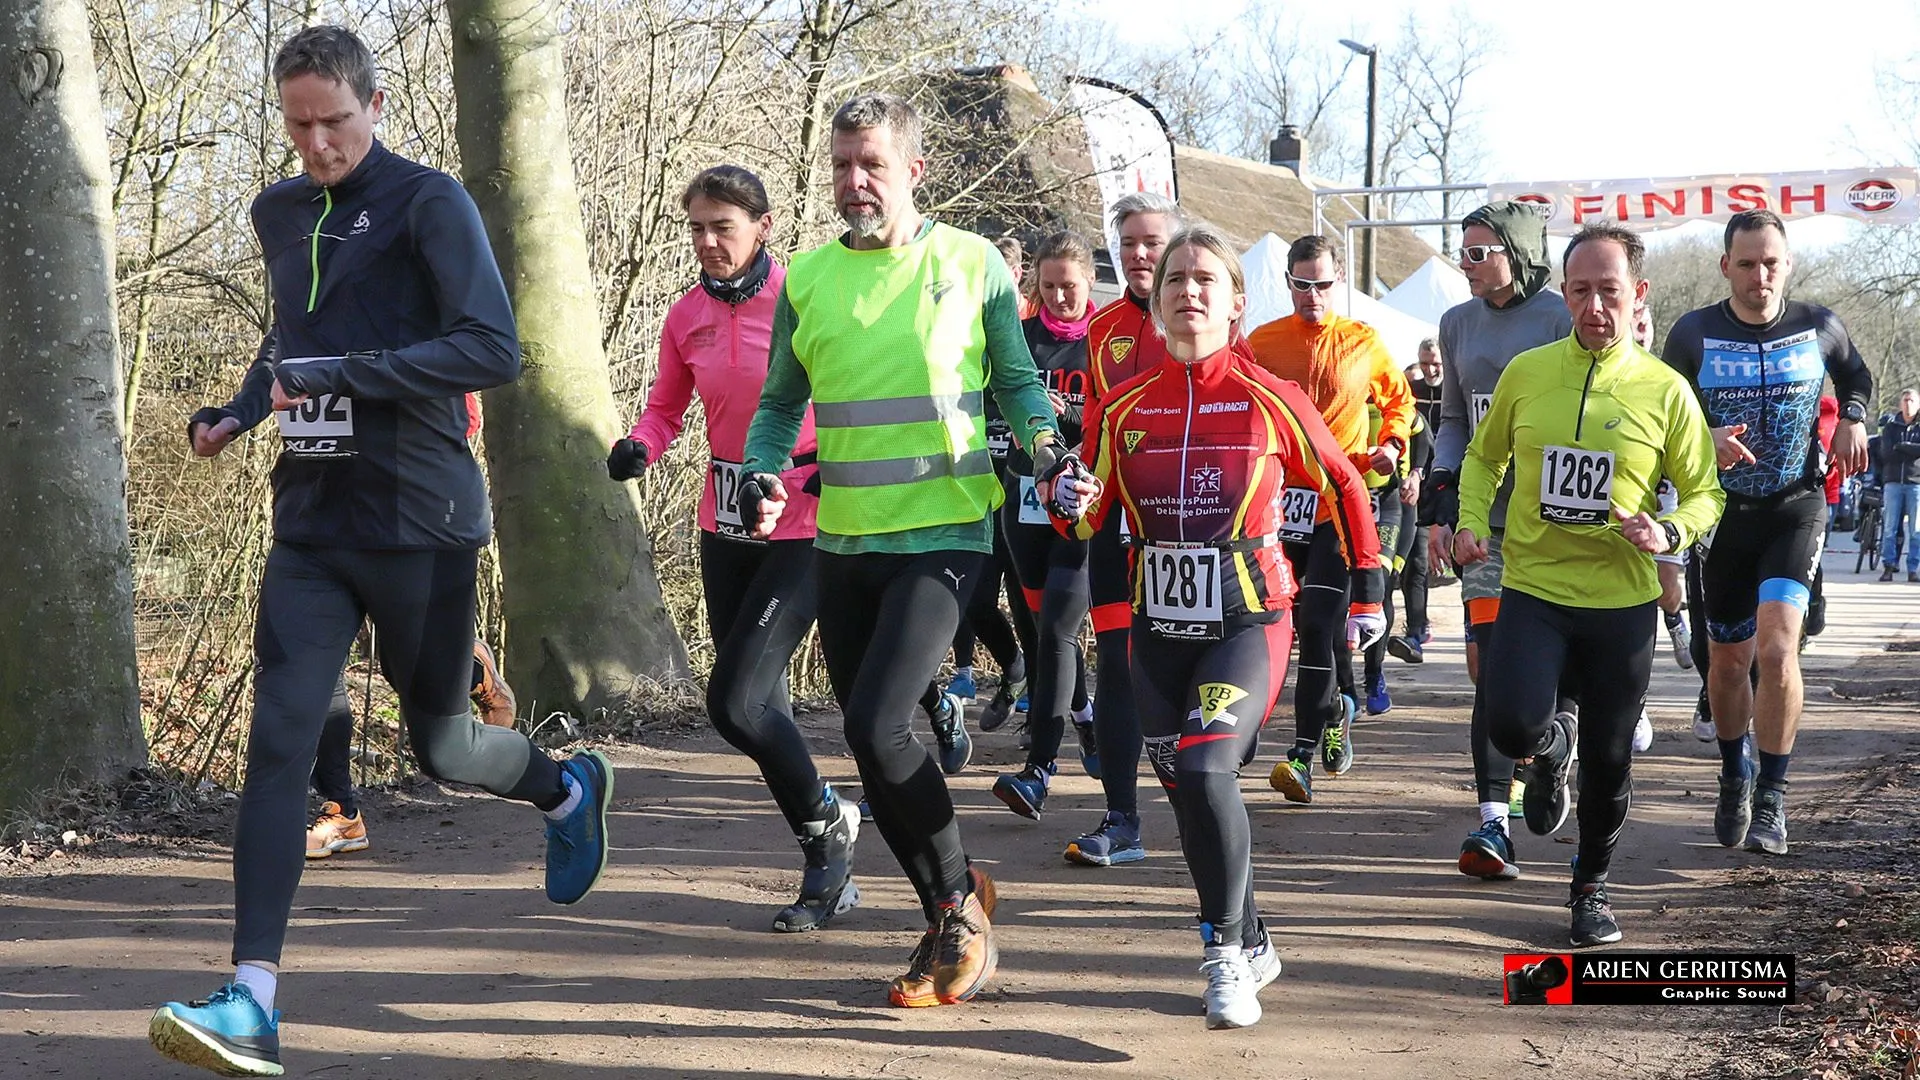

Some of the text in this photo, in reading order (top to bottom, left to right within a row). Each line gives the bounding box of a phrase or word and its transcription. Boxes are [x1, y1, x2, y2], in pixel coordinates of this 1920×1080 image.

[1849, 191, 1897, 201] NIJKERK
[1573, 184, 1825, 225] FINISH
[285, 440, 338, 453] XLC
[1547, 450, 1610, 501] 1262
[1195, 506, 1231, 516] Duinen
[1543, 507, 1597, 521] XLC
[1147, 551, 1216, 609] 1287
[758, 597, 780, 627] FUSION
[1150, 620, 1208, 636] XLC
[1206, 687, 1232, 700] TB
[1205, 698, 1220, 712] S
